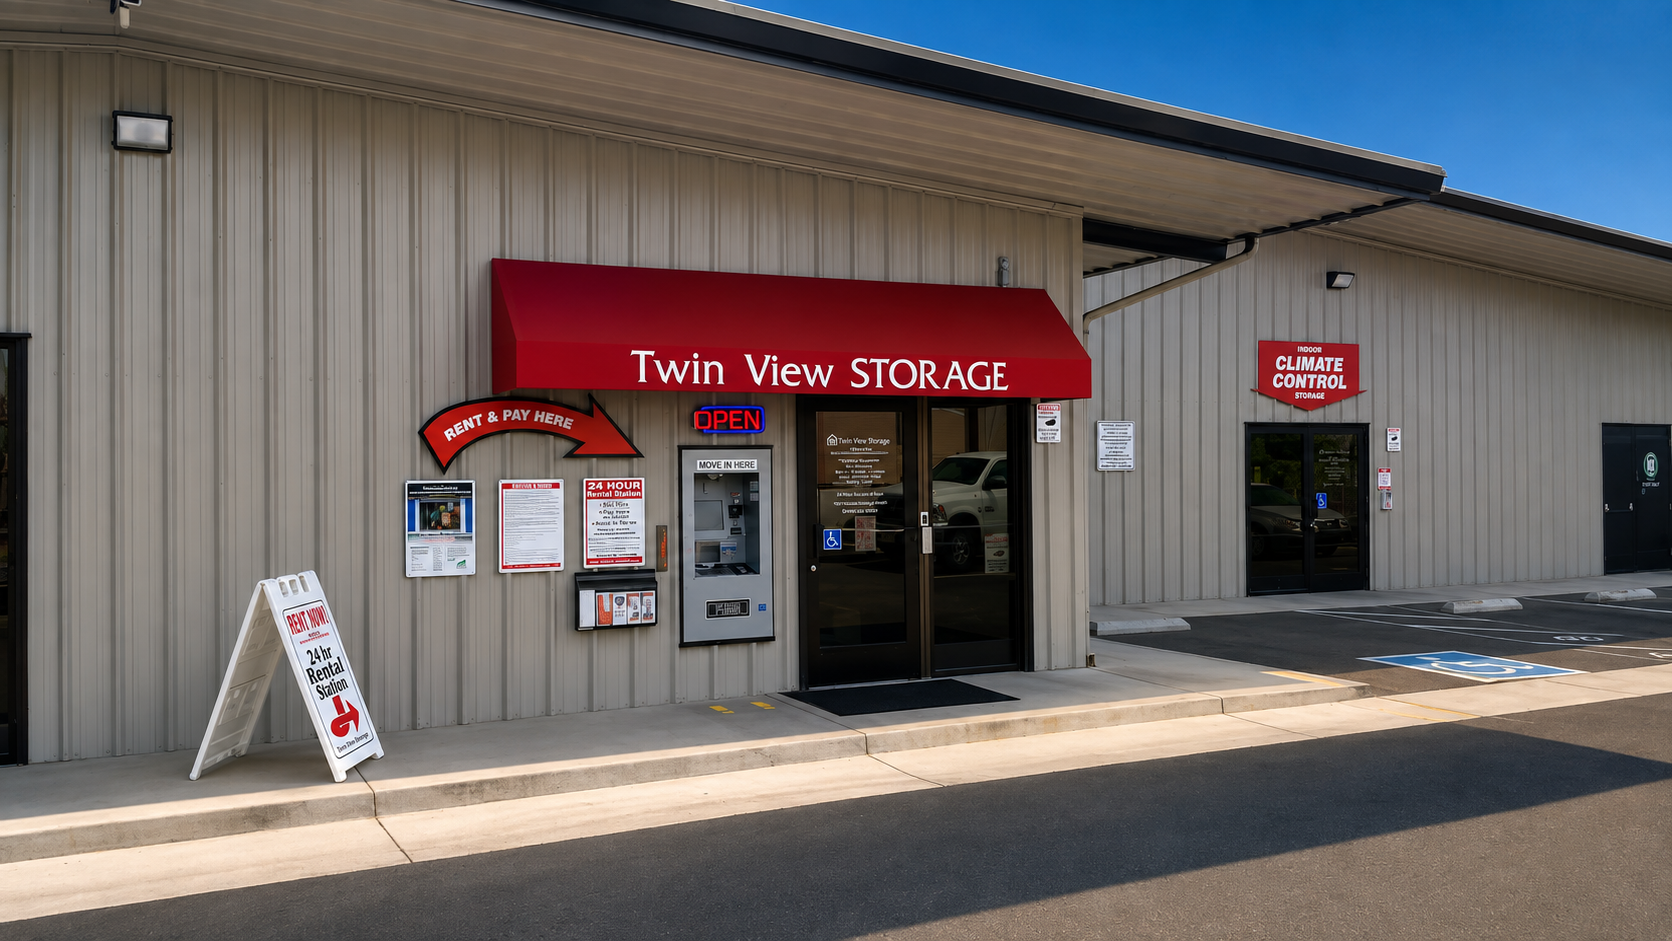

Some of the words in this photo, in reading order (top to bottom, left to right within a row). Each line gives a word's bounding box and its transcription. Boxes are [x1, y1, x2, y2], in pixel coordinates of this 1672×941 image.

[630, 349, 725, 385] Twin
[744, 353, 834, 388] View
[850, 357, 1009, 391] STORAGE
[1275, 355, 1344, 372] CLIMATE
[1272, 373, 1347, 390] CONTROL
[1294, 392, 1325, 400] STORAGE
[443, 414, 483, 442] RENT
[487, 411, 499, 424] &
[502, 409, 531, 422] PAY
[534, 412, 574, 430] HERE
[694, 410, 760, 430] OPEN
[698, 461, 722, 469] MOVE
[723, 461, 732, 469] IN
[733, 461, 756, 469] HERE
[587, 482, 604, 491] 24
[606, 482, 641, 490] HOUR
[286, 612, 310, 635] RENT
[306, 647, 322, 666] 24
[319, 645, 333, 661] hr
[306, 656, 345, 684] Rental
[315, 678, 349, 701] Station
